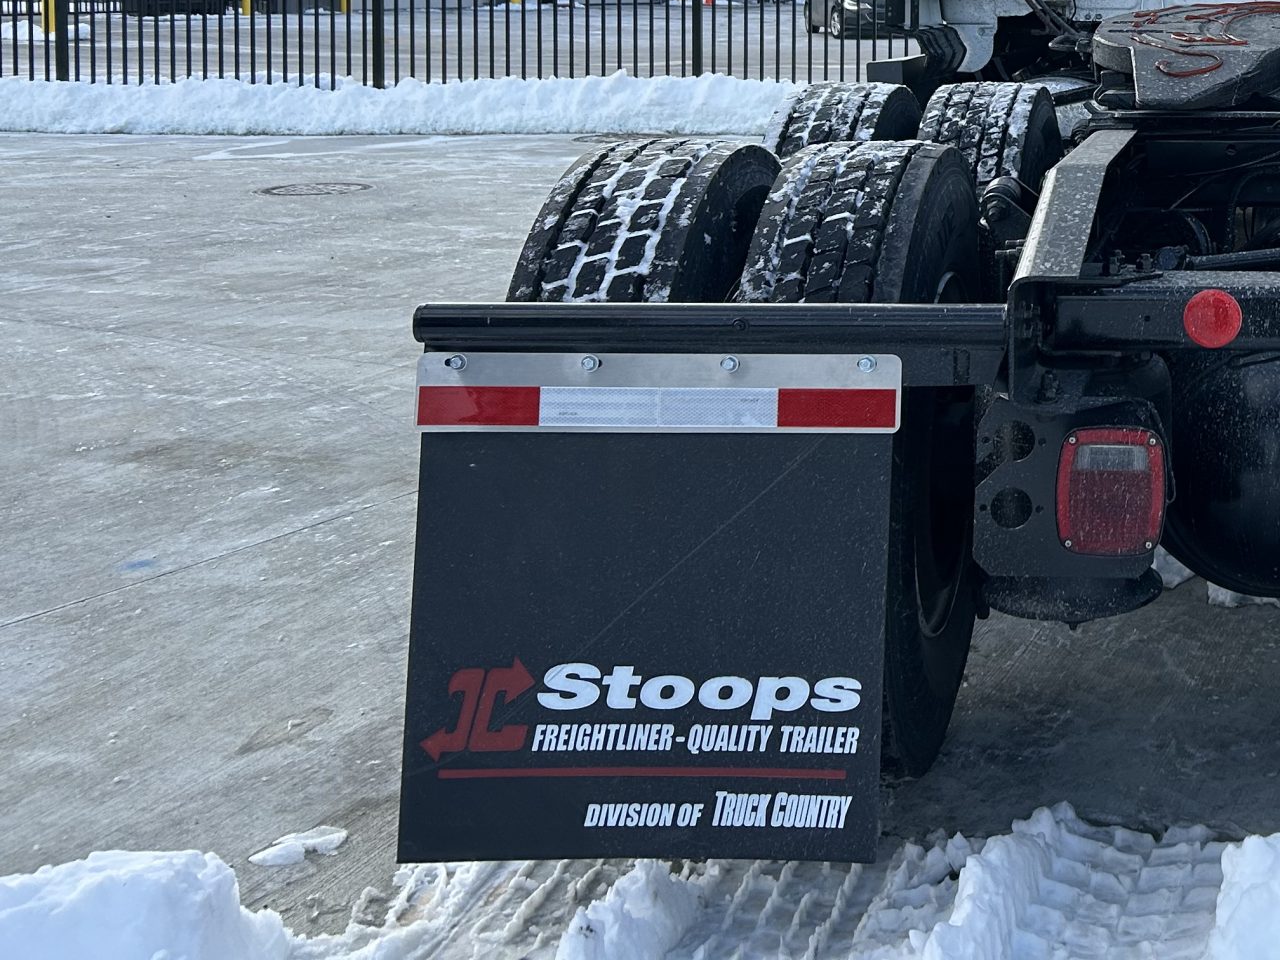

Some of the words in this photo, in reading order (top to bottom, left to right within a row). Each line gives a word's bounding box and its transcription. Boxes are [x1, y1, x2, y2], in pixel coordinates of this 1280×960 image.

[536, 662, 863, 721] Stoops
[779, 725, 860, 754] TRAILER
[583, 803, 676, 828] DIVISION
[676, 803, 705, 827] OF
[711, 790, 772, 828] TRUCK
[770, 791, 853, 830] COUNTRY
